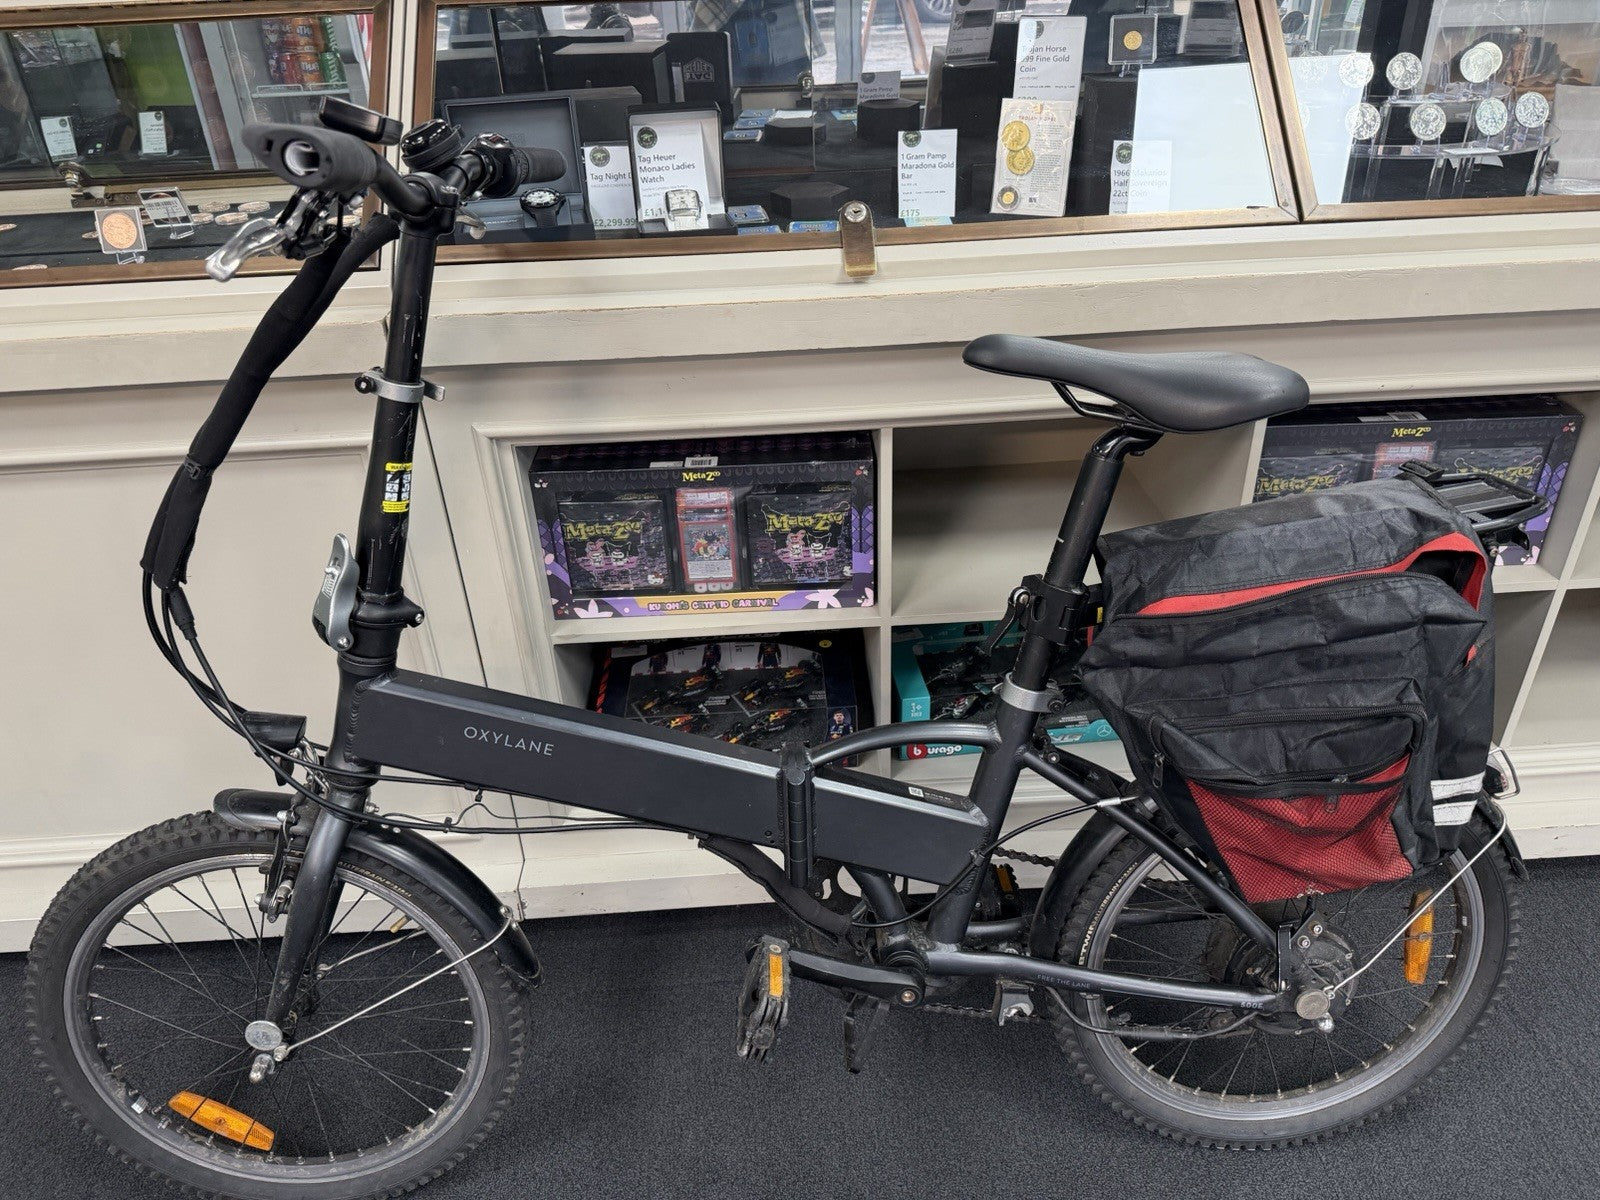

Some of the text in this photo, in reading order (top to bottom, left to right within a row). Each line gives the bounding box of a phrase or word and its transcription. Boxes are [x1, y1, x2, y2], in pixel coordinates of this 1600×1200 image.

[1020, 65, 1036, 73] Coin
[638, 154, 676, 164] Tag Heuer
[926, 152, 947, 160] Pamp
[640, 161, 696, 173] Monaco Ladies
[938, 161, 954, 169] Gold
[591, 173, 604, 182] Tag
[605, 171, 626, 182] Night
[1113, 169, 1130, 177] 1966
[640, 174, 665, 184] Watch
[1113, 179, 1129, 187] Half
[1112, 189, 1128, 197] 22ct
[900, 209, 920, 217] £175
[594, 217, 637, 228] £2,299.99
[463, 726, 555, 756] OXYLANE
[1037, 974, 1091, 989] FREE THE LANE
